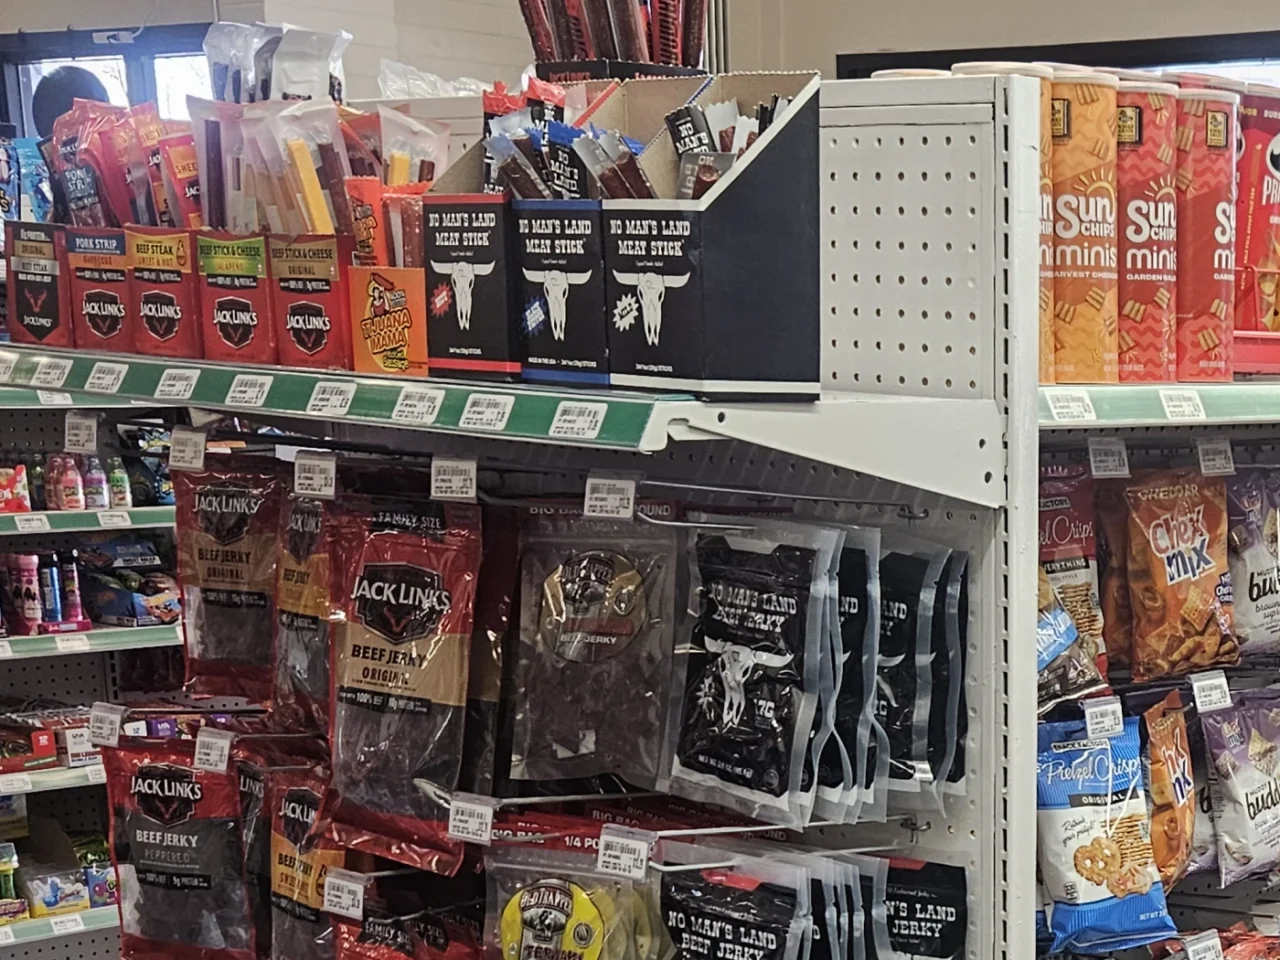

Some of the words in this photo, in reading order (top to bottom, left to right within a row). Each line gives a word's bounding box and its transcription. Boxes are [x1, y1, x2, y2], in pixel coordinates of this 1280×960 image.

[429, 213, 440, 227] NO
[442, 213, 469, 227] MAN'S
[472, 213, 496, 227] LAND
[519, 219, 529, 233] NO
[532, 219, 562, 233] MAN'S
[565, 220, 591, 234] LAND
[610, 220, 622, 235] NO
[625, 220, 657, 236] MAN'S
[661, 221, 690, 236] LAND
[1126, 199, 1176, 243] Sun
[436, 232, 457, 246] MEAT
[459, 232, 489, 246] STICK
[1081, 223, 1114, 238] CHIPS
[75, 237, 92, 249] PORK
[94, 238, 117, 250] STRIP
[136, 244, 154, 255] BEEF
[155, 245, 174, 256] STEAK
[216, 245, 233, 256] STICK
[238, 246, 261, 257] CHEESE
[526, 240, 551, 254] MEAT
[554, 240, 584, 254] STICK
[618, 241, 647, 255] MEAT
[650, 241, 682, 256] STICK
[285, 248, 303, 260] STICK
[308, 249, 333, 260] CHEESE
[1056, 243, 1116, 267] minis
[361, 311, 412, 339] TIJUANA
[1138, 483, 1199, 501] CHEDDAR
[193, 494, 221, 513] JACK
[422, 517, 441, 529] SIZE
[1052, 516, 1094, 546] Crisps
[1150, 506, 1206, 556] Chex
[198, 549, 220, 562] BEEF
[220, 551, 251, 564] JERKY
[1166, 538, 1212, 584] mix
[207, 567, 244, 580] ORIGINAL
[351, 576, 398, 600] JACK
[762, 593, 797, 615] LAND
[584, 636, 617, 645] JERKY
[351, 644, 385, 664] BEEF
[386, 652, 426, 669] JERKY
[1048, 760, 1094, 790] Pretzel
[130, 776, 164, 796] JACK
[1082, 792, 1126, 804] ORIGINAL
[136, 830, 162, 843] BEEF
[163, 834, 198, 847] JERKY
[145, 849, 190, 862] PEPPERED
[916, 903, 956, 921] LAND
[668, 911, 685, 927] NO
[692, 918, 734, 939] MAN'S
[740, 927, 777, 950] LAND
[892, 920, 942, 938] JERKY
[681, 934, 714, 953] BEEF
